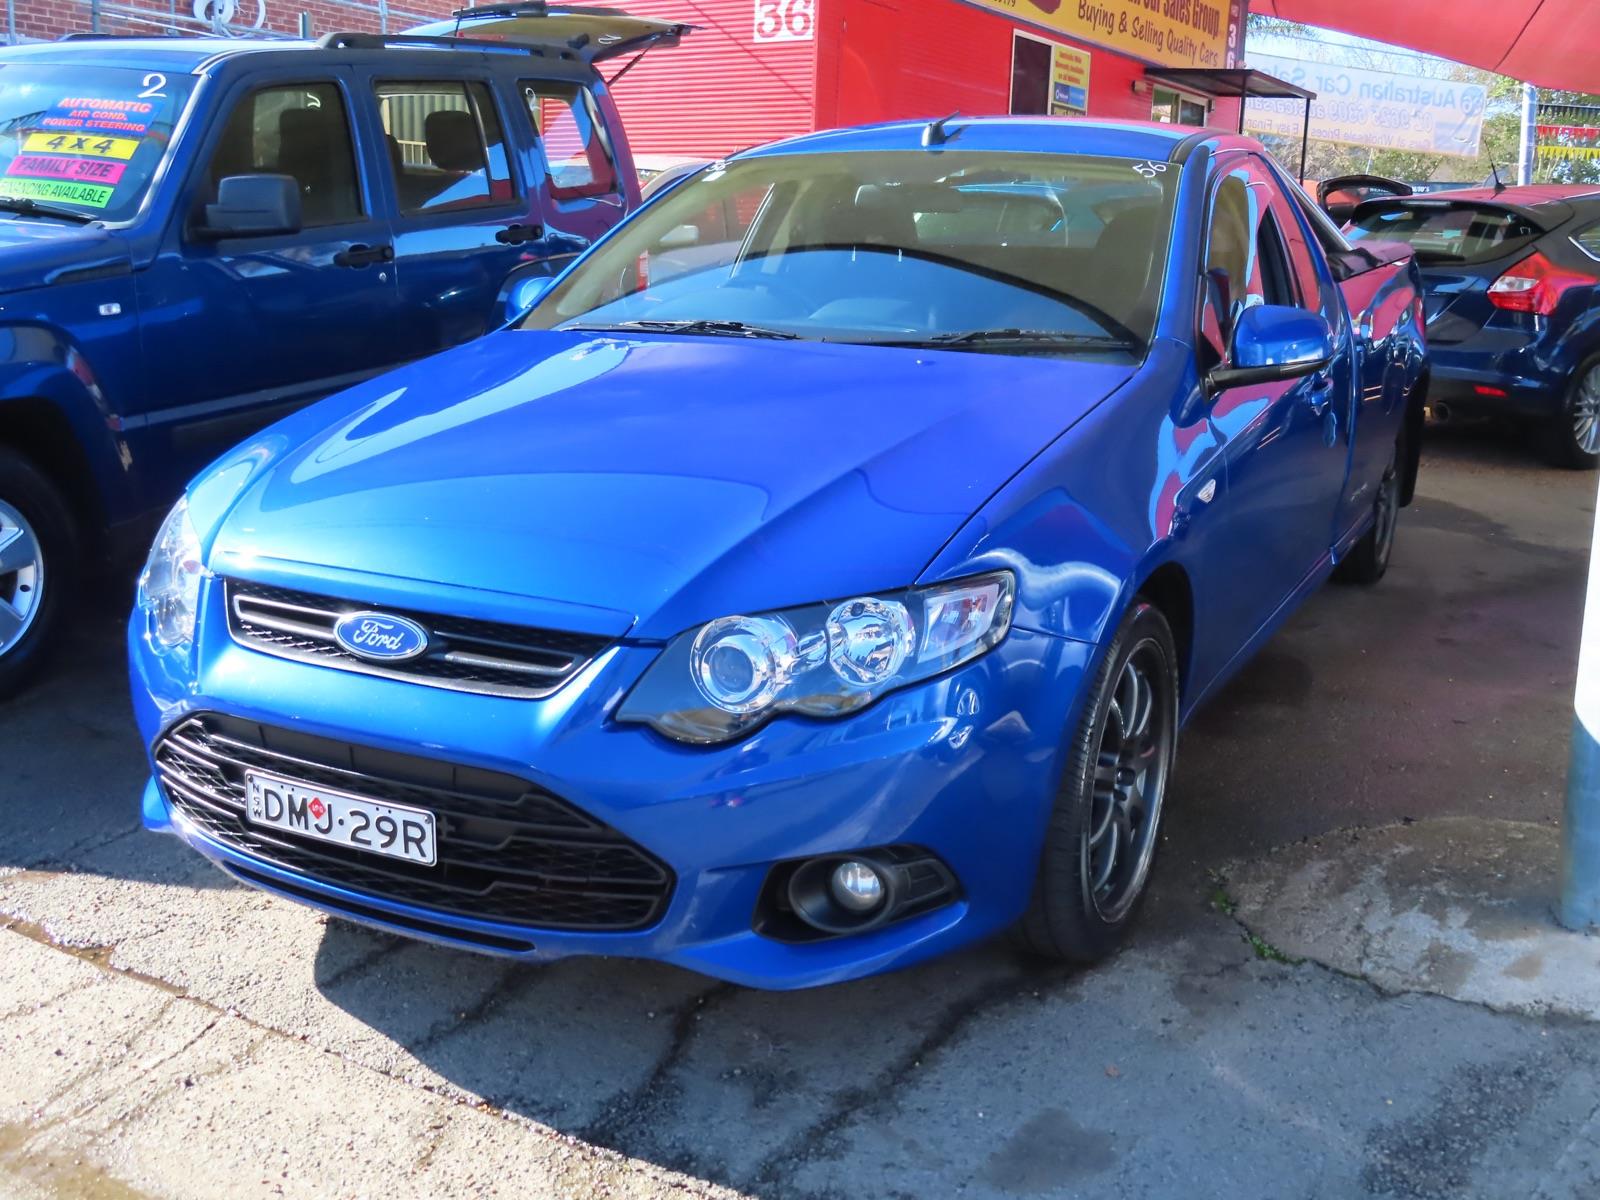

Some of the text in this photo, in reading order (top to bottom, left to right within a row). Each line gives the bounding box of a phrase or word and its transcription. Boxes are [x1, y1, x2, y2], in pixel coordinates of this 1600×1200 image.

[1192, 0, 1220, 40] Group
[1077, 0, 1219, 67] Buying & Selling Quality Cars
[137, 73, 167, 98] 2
[57, 97, 153, 113] AUTOMATIC
[69, 110, 128, 120] AIR COND.
[42, 118, 146, 132] POWER STEERING
[17, 156, 114, 178] FAMILY SIZE
[49, 184, 107, 203] AVAILABLE
[353, 619, 402, 651] Ford
